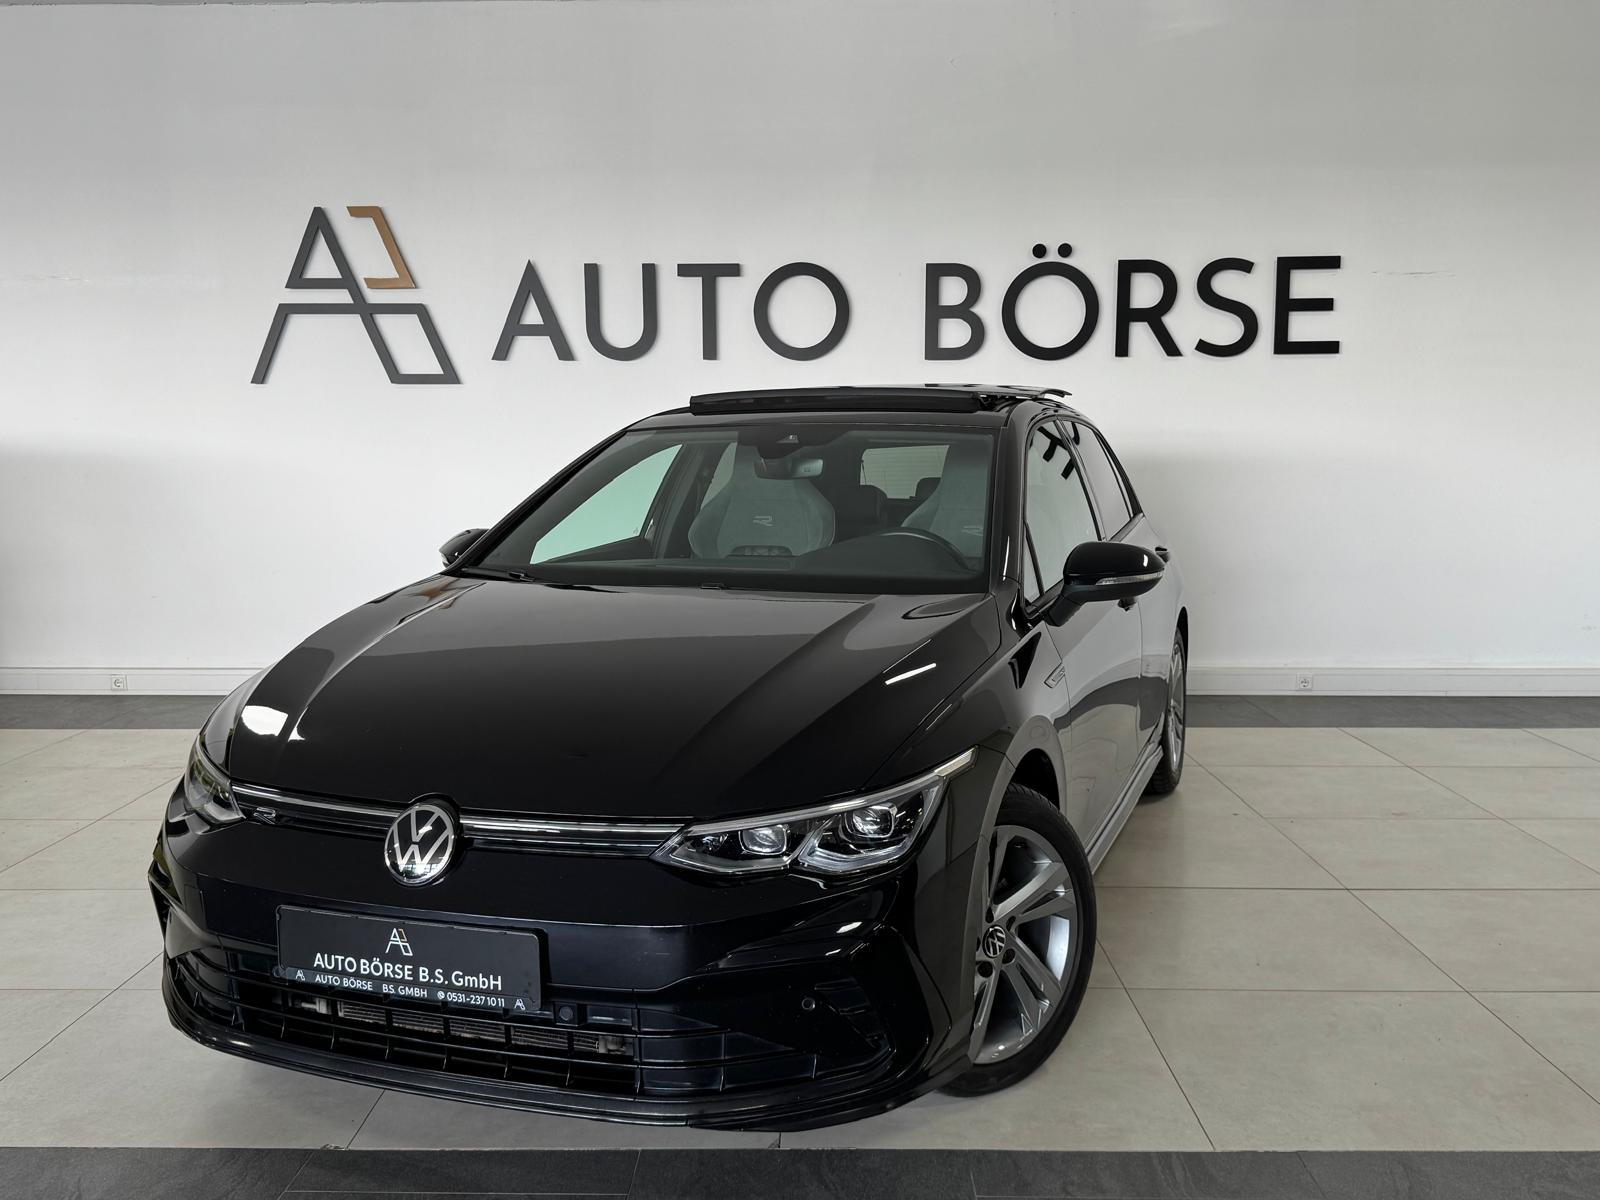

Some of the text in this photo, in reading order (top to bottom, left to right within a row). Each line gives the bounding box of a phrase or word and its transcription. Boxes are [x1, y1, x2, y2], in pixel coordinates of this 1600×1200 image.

[491, 242, 1342, 361] AUTO BÖRSE
[313, 952, 502, 991] AUTO BÖRSE B.S. GmbH
[314, 974, 341, 986] AUTO
[343, 976, 374, 991] BÖRSE
[397, 985, 428, 998] GMBH
